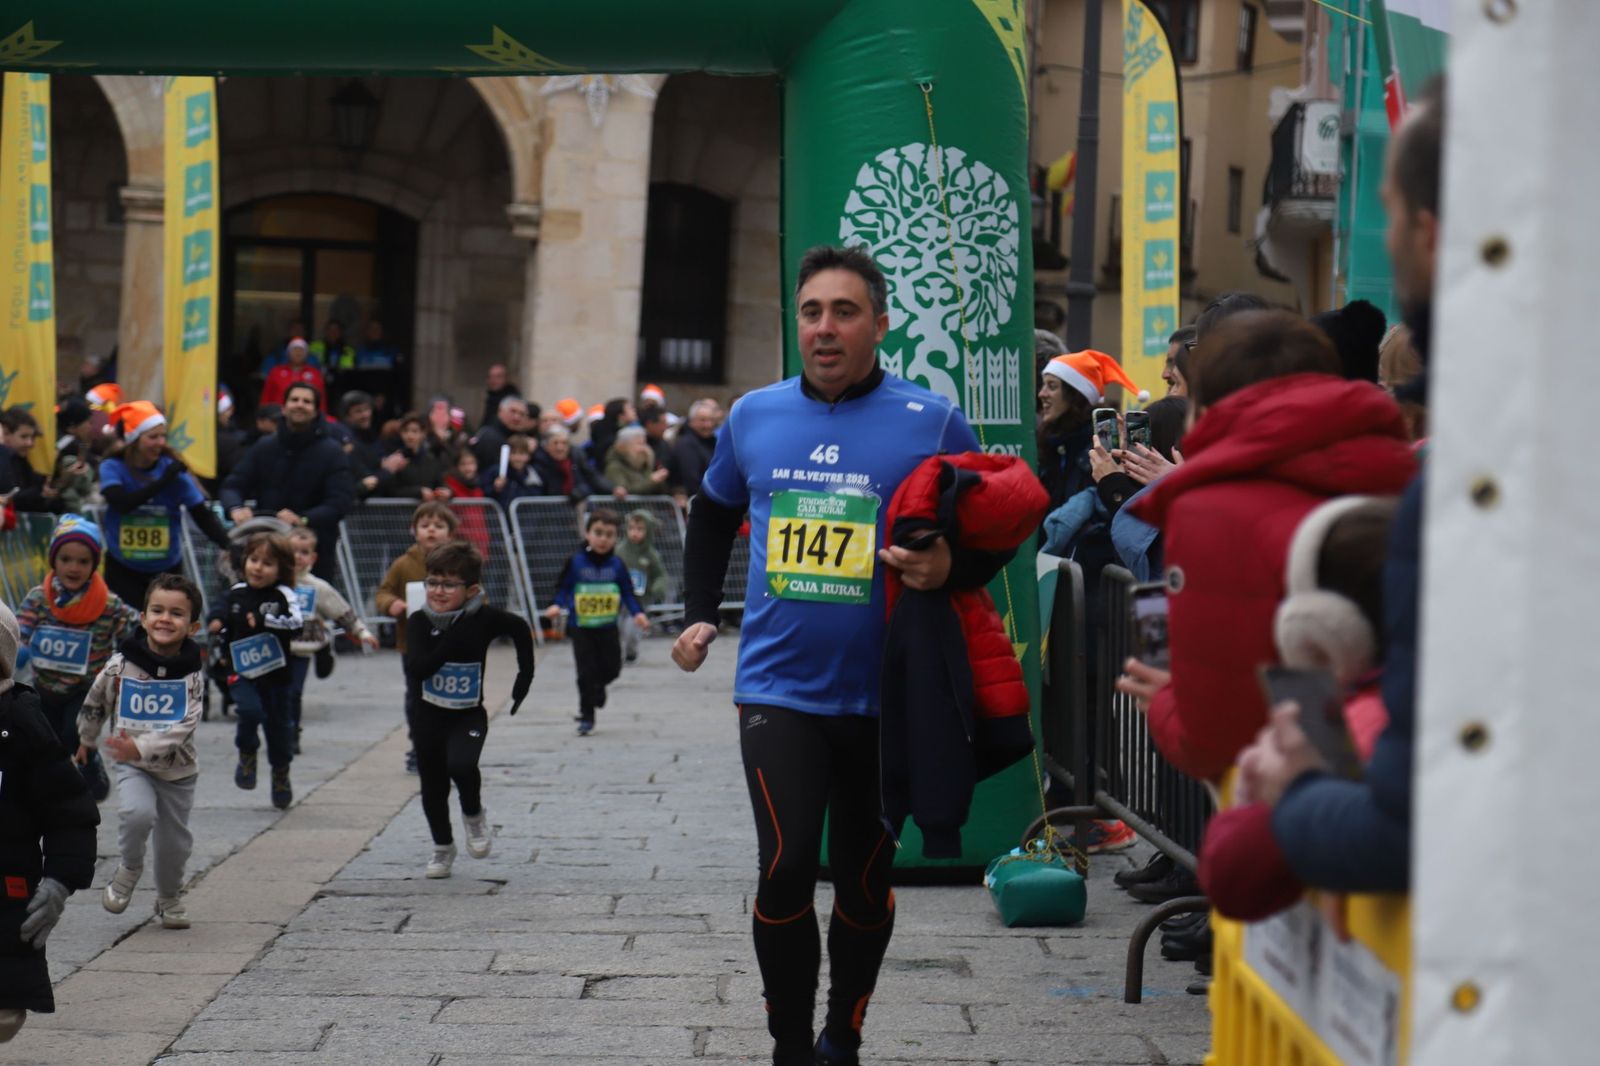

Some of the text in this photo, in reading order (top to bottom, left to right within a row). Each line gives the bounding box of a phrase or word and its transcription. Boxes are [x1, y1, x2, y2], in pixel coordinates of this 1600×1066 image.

[809, 444, 840, 464] 46
[772, 468, 791, 479] SAN
[793, 469, 844, 483] SILVESTRE
[797, 504, 847, 515] CAJA RURAL
[122, 528, 162, 548] 398
[779, 523, 854, 567] 1147
[789, 580, 864, 596] CAJA RURAL
[40, 637, 80, 659] 097
[240, 644, 272, 667] 064
[432, 673, 471, 694] 083
[130, 693, 174, 714] 062
